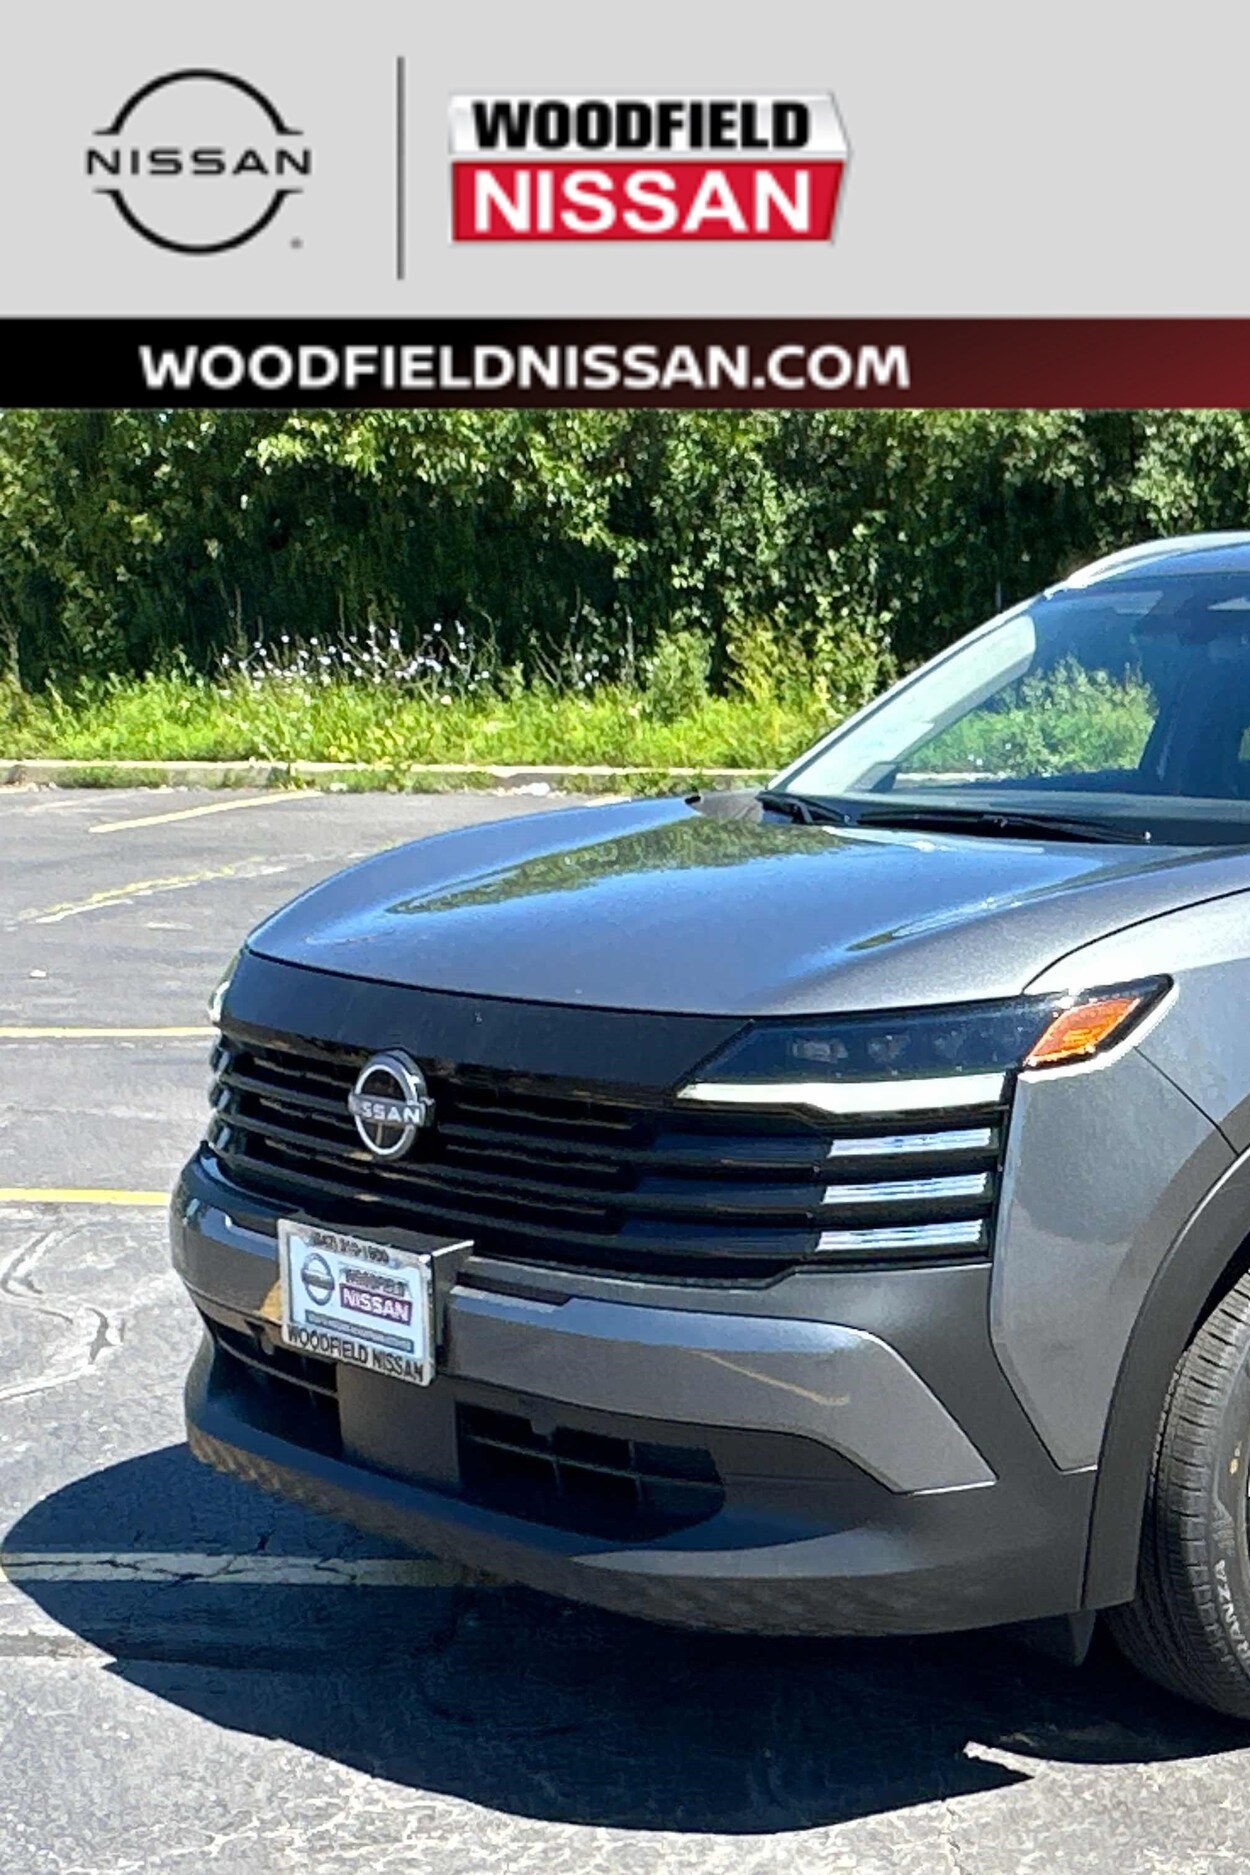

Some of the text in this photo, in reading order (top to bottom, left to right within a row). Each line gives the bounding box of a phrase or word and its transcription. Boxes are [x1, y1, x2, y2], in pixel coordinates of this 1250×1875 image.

[343, 1288, 409, 1321] NISSAN
[288, 1325, 368, 1364] WOODFIELD
[372, 1347, 423, 1382] NISSAN
